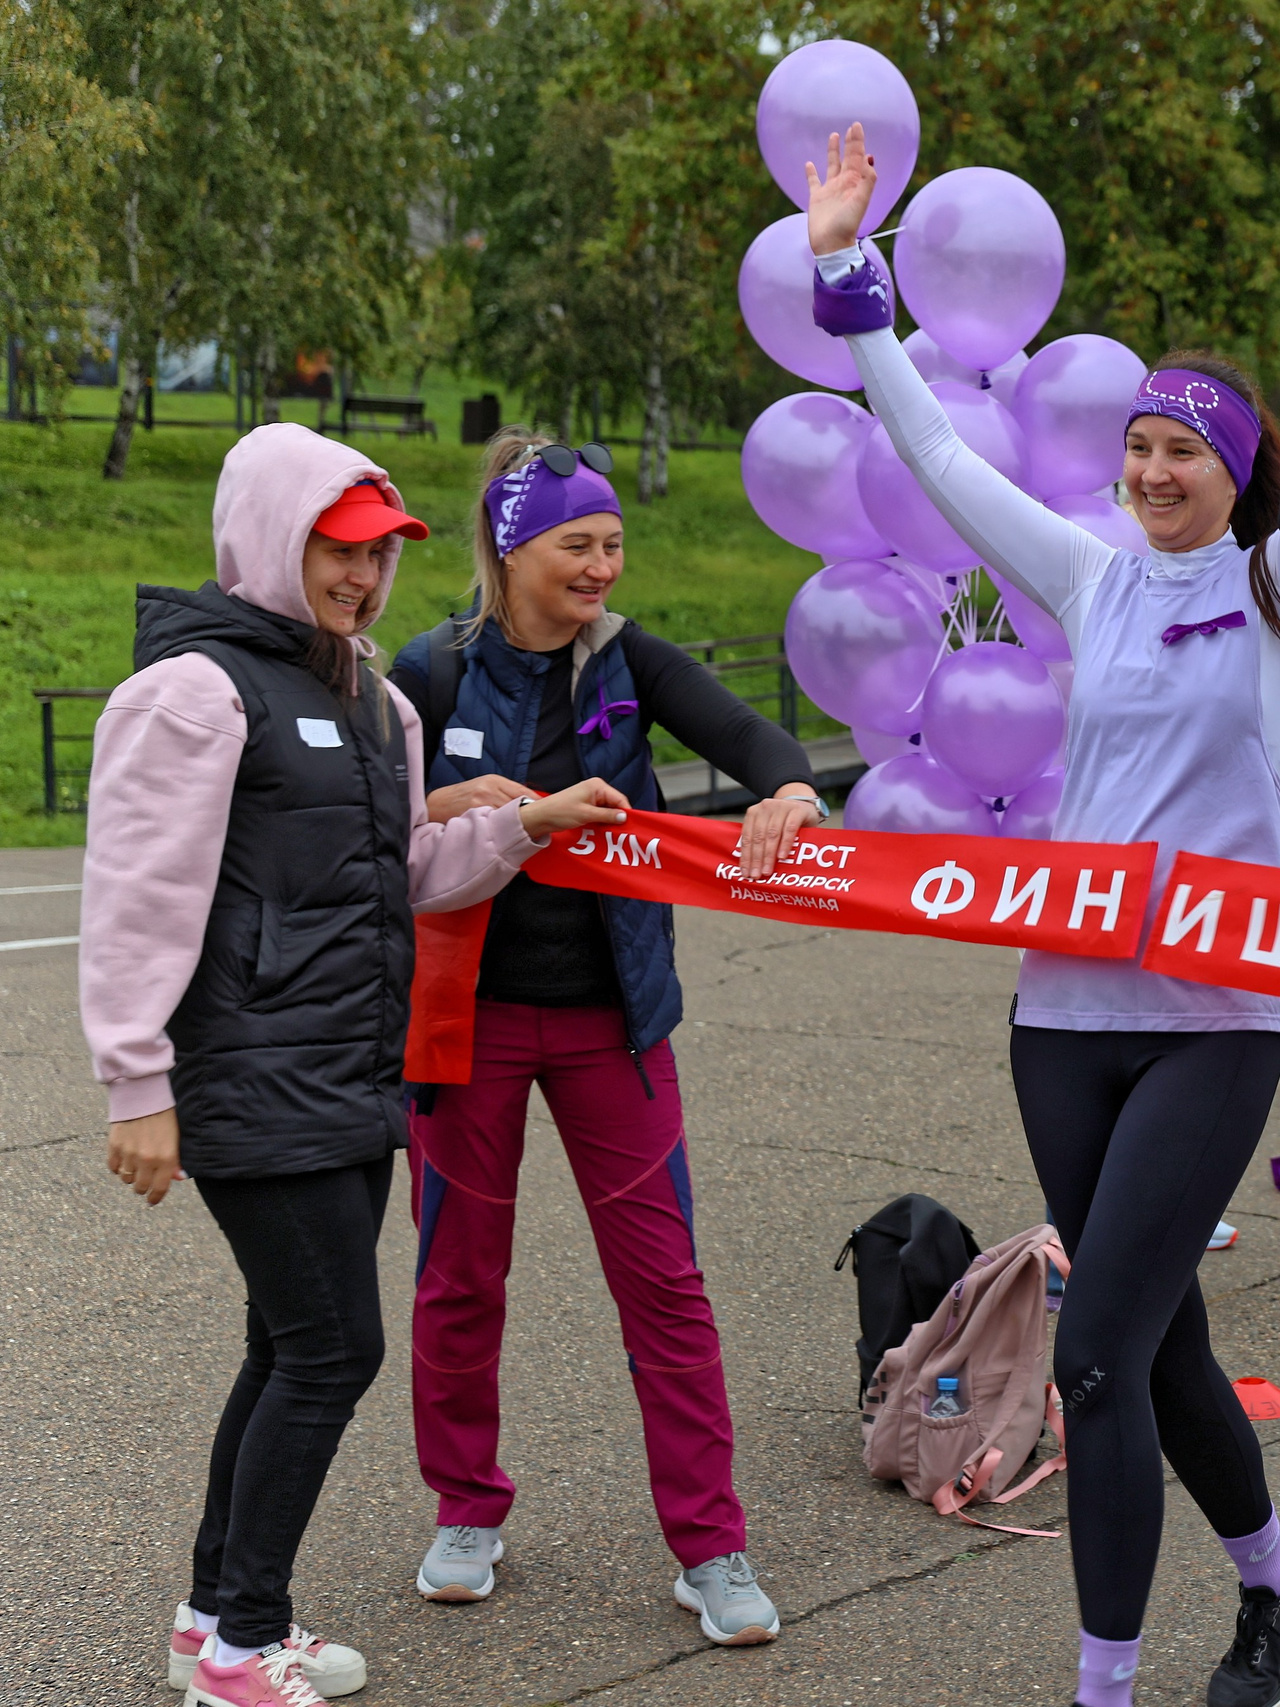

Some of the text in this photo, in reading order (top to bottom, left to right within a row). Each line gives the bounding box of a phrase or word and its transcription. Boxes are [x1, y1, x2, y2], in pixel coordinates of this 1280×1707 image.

[496, 463, 531, 560] RAIL
[567, 829, 662, 869] 5 КМ
[731, 885, 840, 912] НАБЕРЕЖНАЯ
